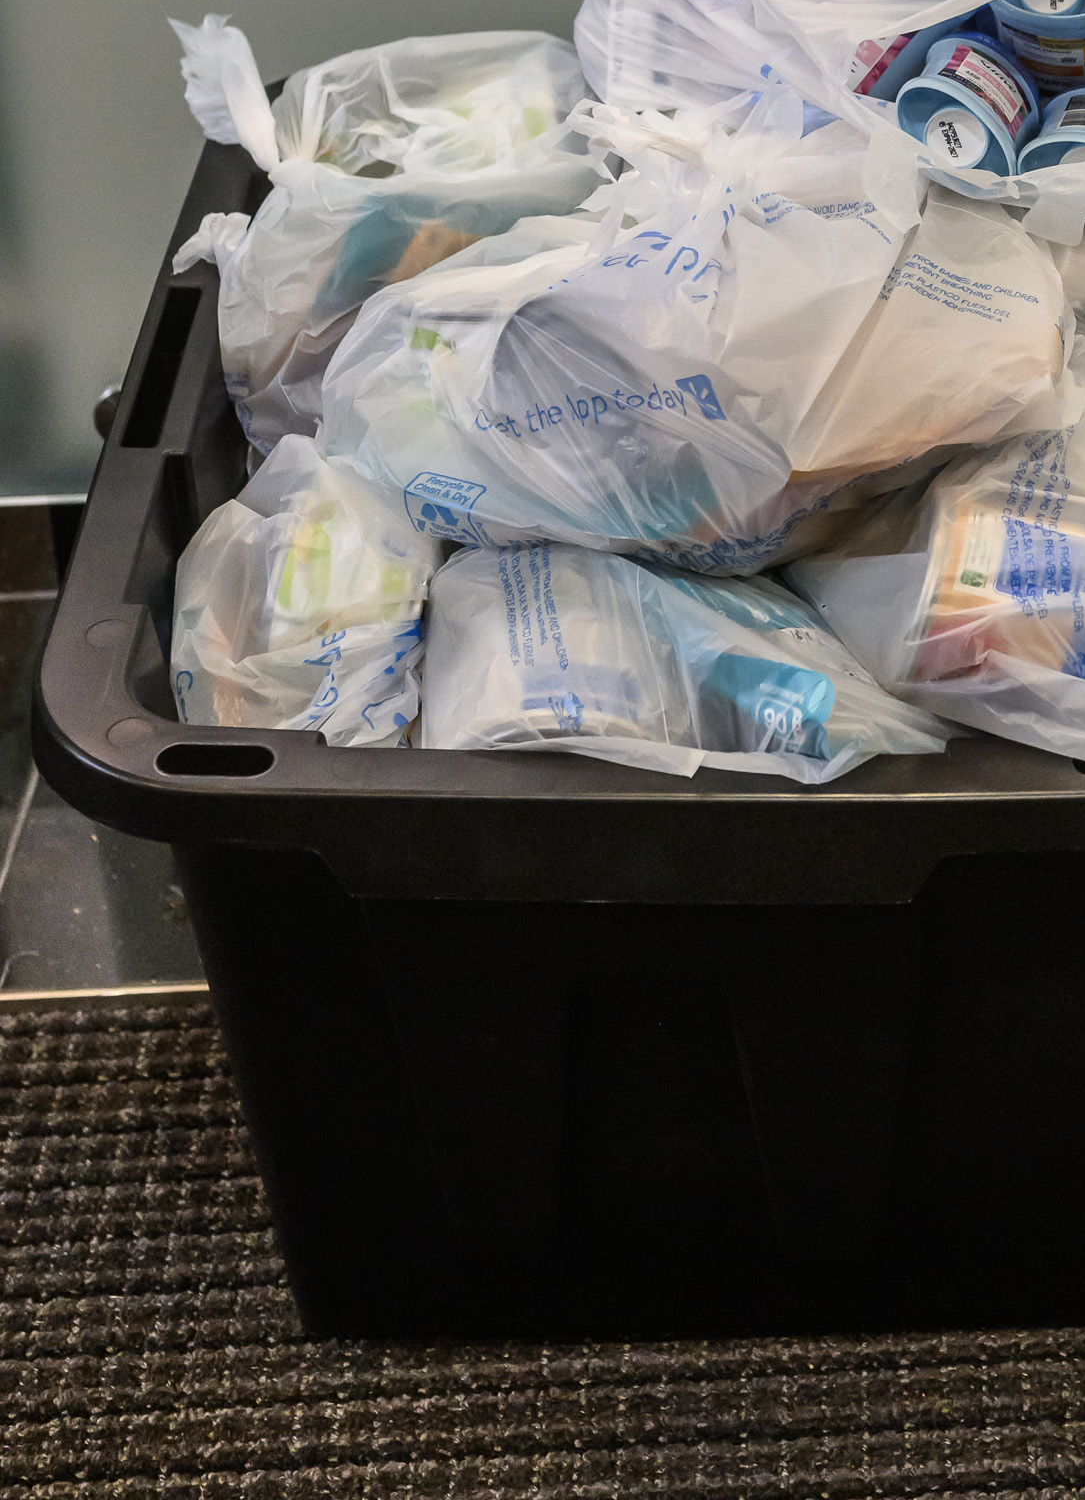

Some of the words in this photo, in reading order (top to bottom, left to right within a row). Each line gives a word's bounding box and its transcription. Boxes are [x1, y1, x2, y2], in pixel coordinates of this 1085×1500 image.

[904, 262, 940, 280] REVENT
[941, 278, 995, 301] BREATHING
[912, 254, 938, 270] FROM
[971, 282, 992, 291] AND
[994, 286, 1040, 304] CHILDREN
[961, 299, 992, 313] FUERA
[526, 403, 563, 434] the
[614, 383, 688, 416] today
[413, 483, 442, 496] Clean
[452, 491, 472, 505] Dry
[425, 476, 465, 491] Recycle
